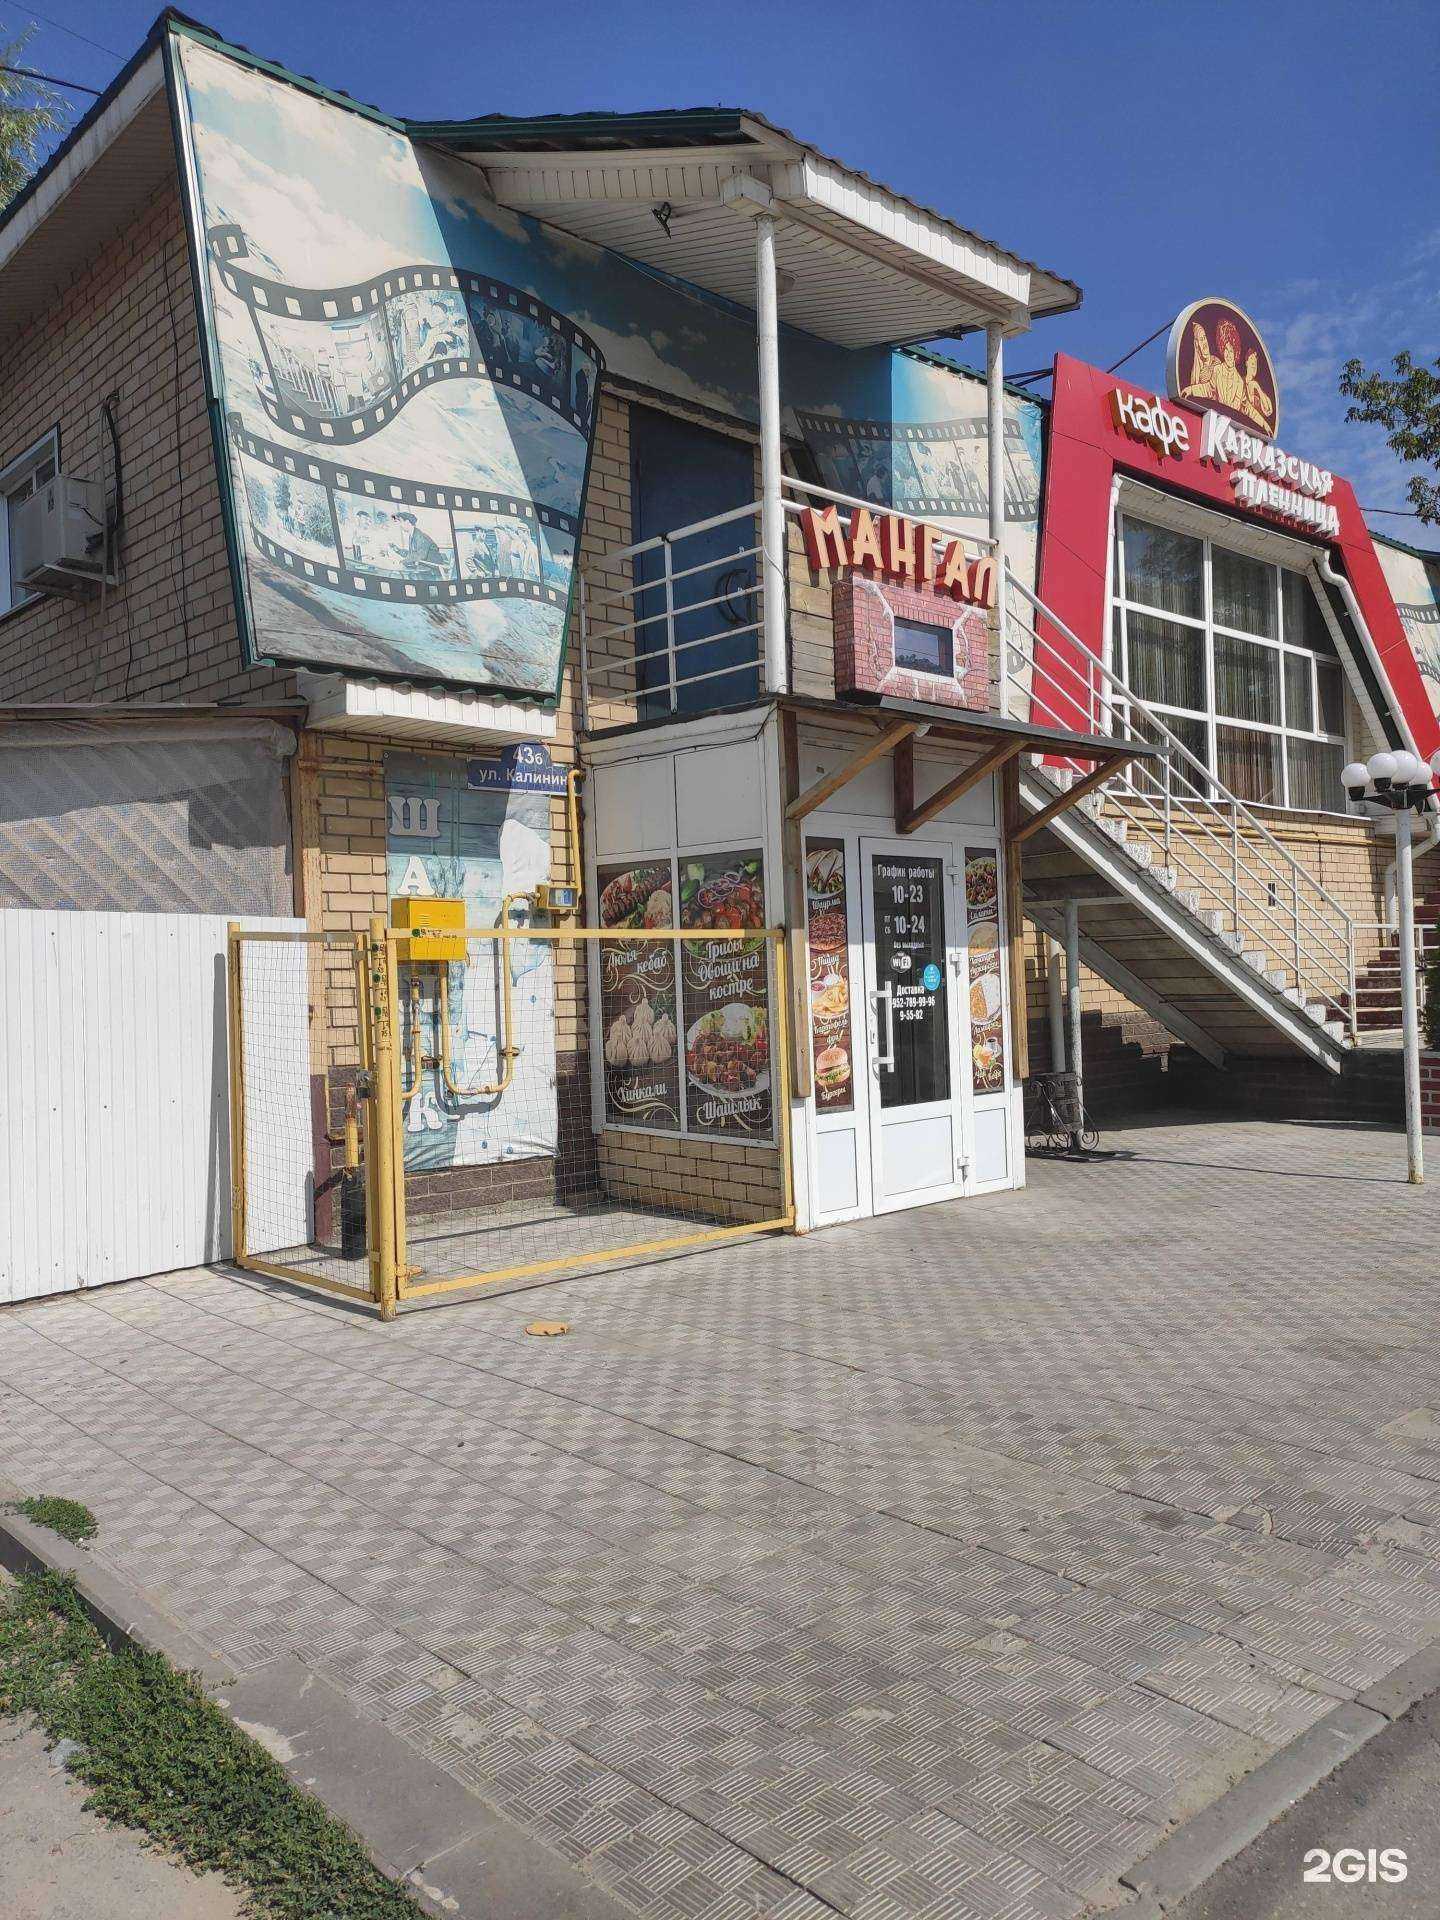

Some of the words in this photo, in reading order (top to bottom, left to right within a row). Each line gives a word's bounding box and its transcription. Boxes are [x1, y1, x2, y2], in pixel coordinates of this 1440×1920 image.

[1112, 388, 1191, 456] кафе
[801, 505, 999, 609] МАНГАЛ
[479, 768, 501, 783] ул.
[506, 767, 570, 785] Калинин
[877, 864, 905, 879] График
[908, 866, 934, 879] работы
[892, 885, 923, 903] 10-23
[894, 915, 925, 934] 10-24
[706, 938, 744, 962] Грибы
[637, 951, 667, 973] кебаб
[709, 976, 753, 1000] костре
[897, 985, 924, 996] Доставка
[900, 1009, 923, 1021] 9-55-82
